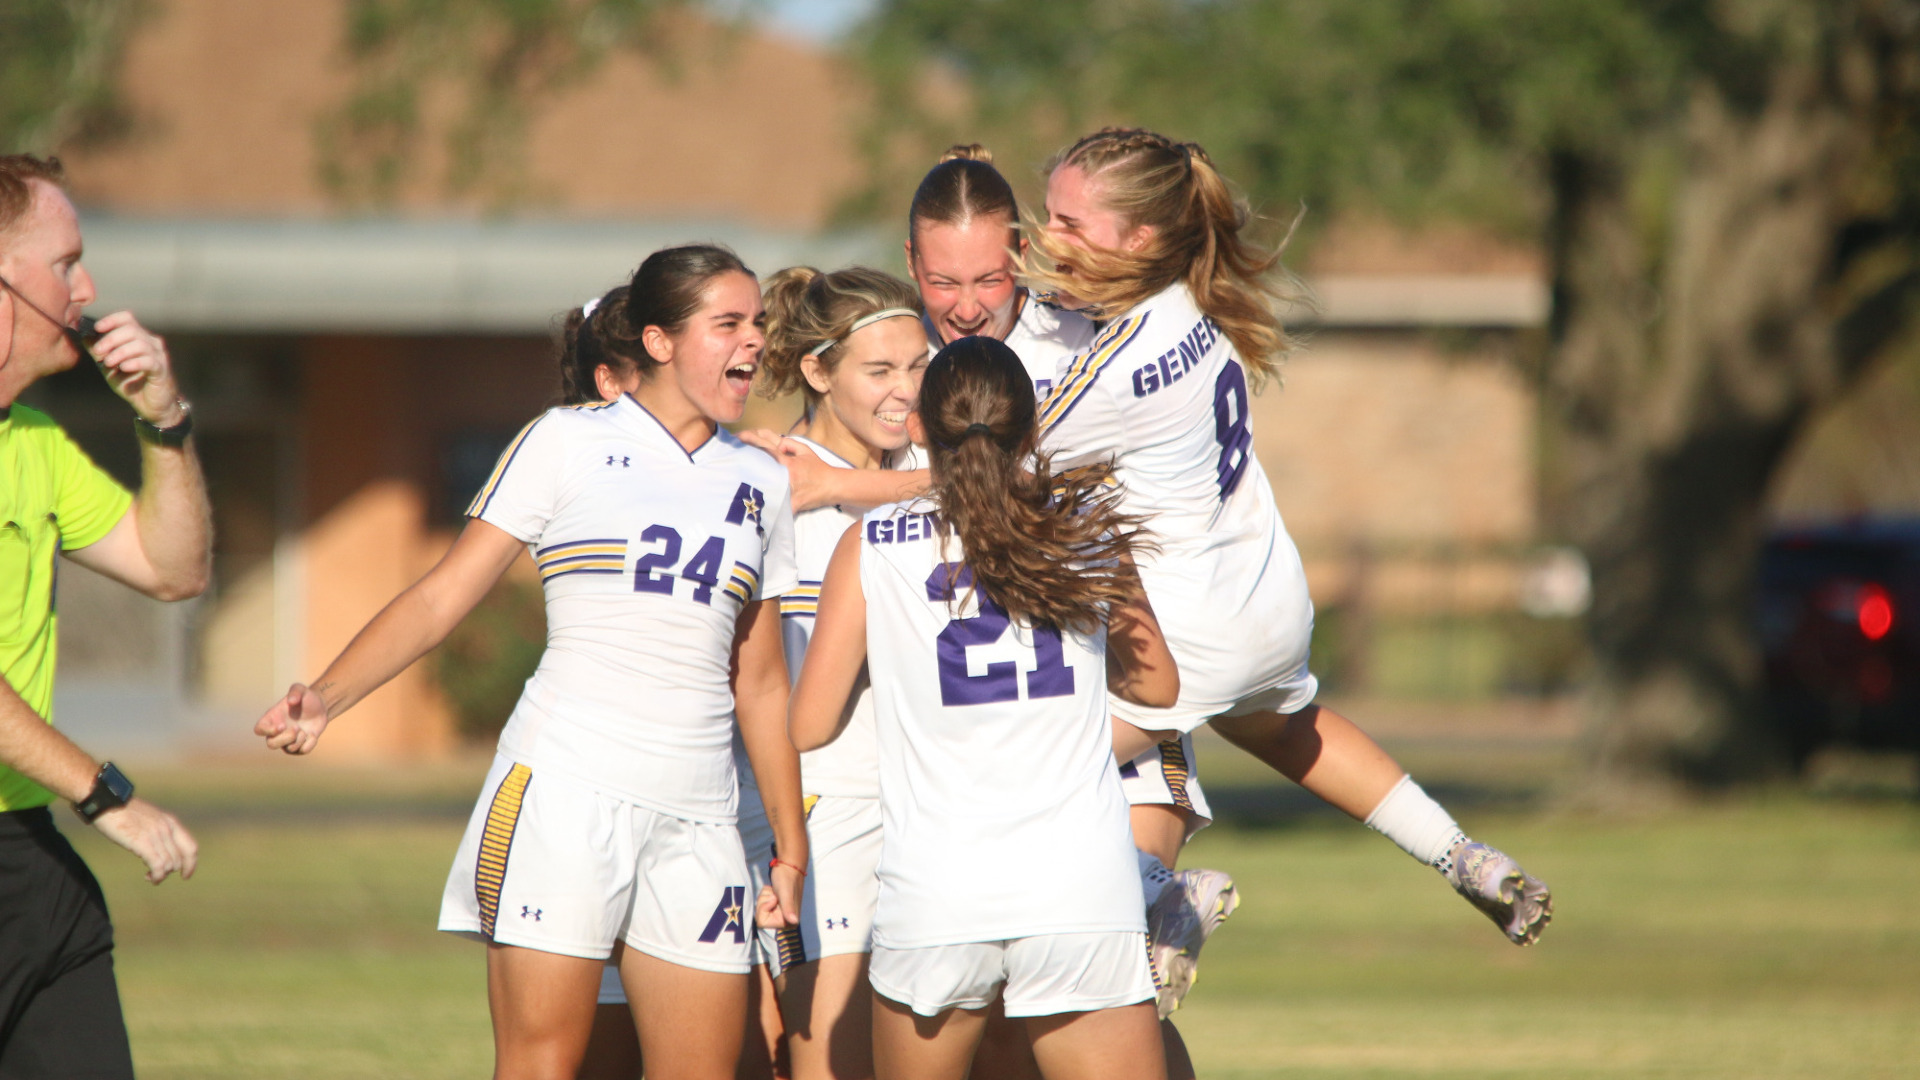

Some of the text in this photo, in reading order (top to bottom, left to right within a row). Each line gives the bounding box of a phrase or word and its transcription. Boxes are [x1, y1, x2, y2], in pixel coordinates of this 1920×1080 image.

[1213, 359, 1251, 501] 8
[635, 525, 725, 606] 24
[867, 513, 960, 545] GEN
[926, 562, 1075, 707] 21
